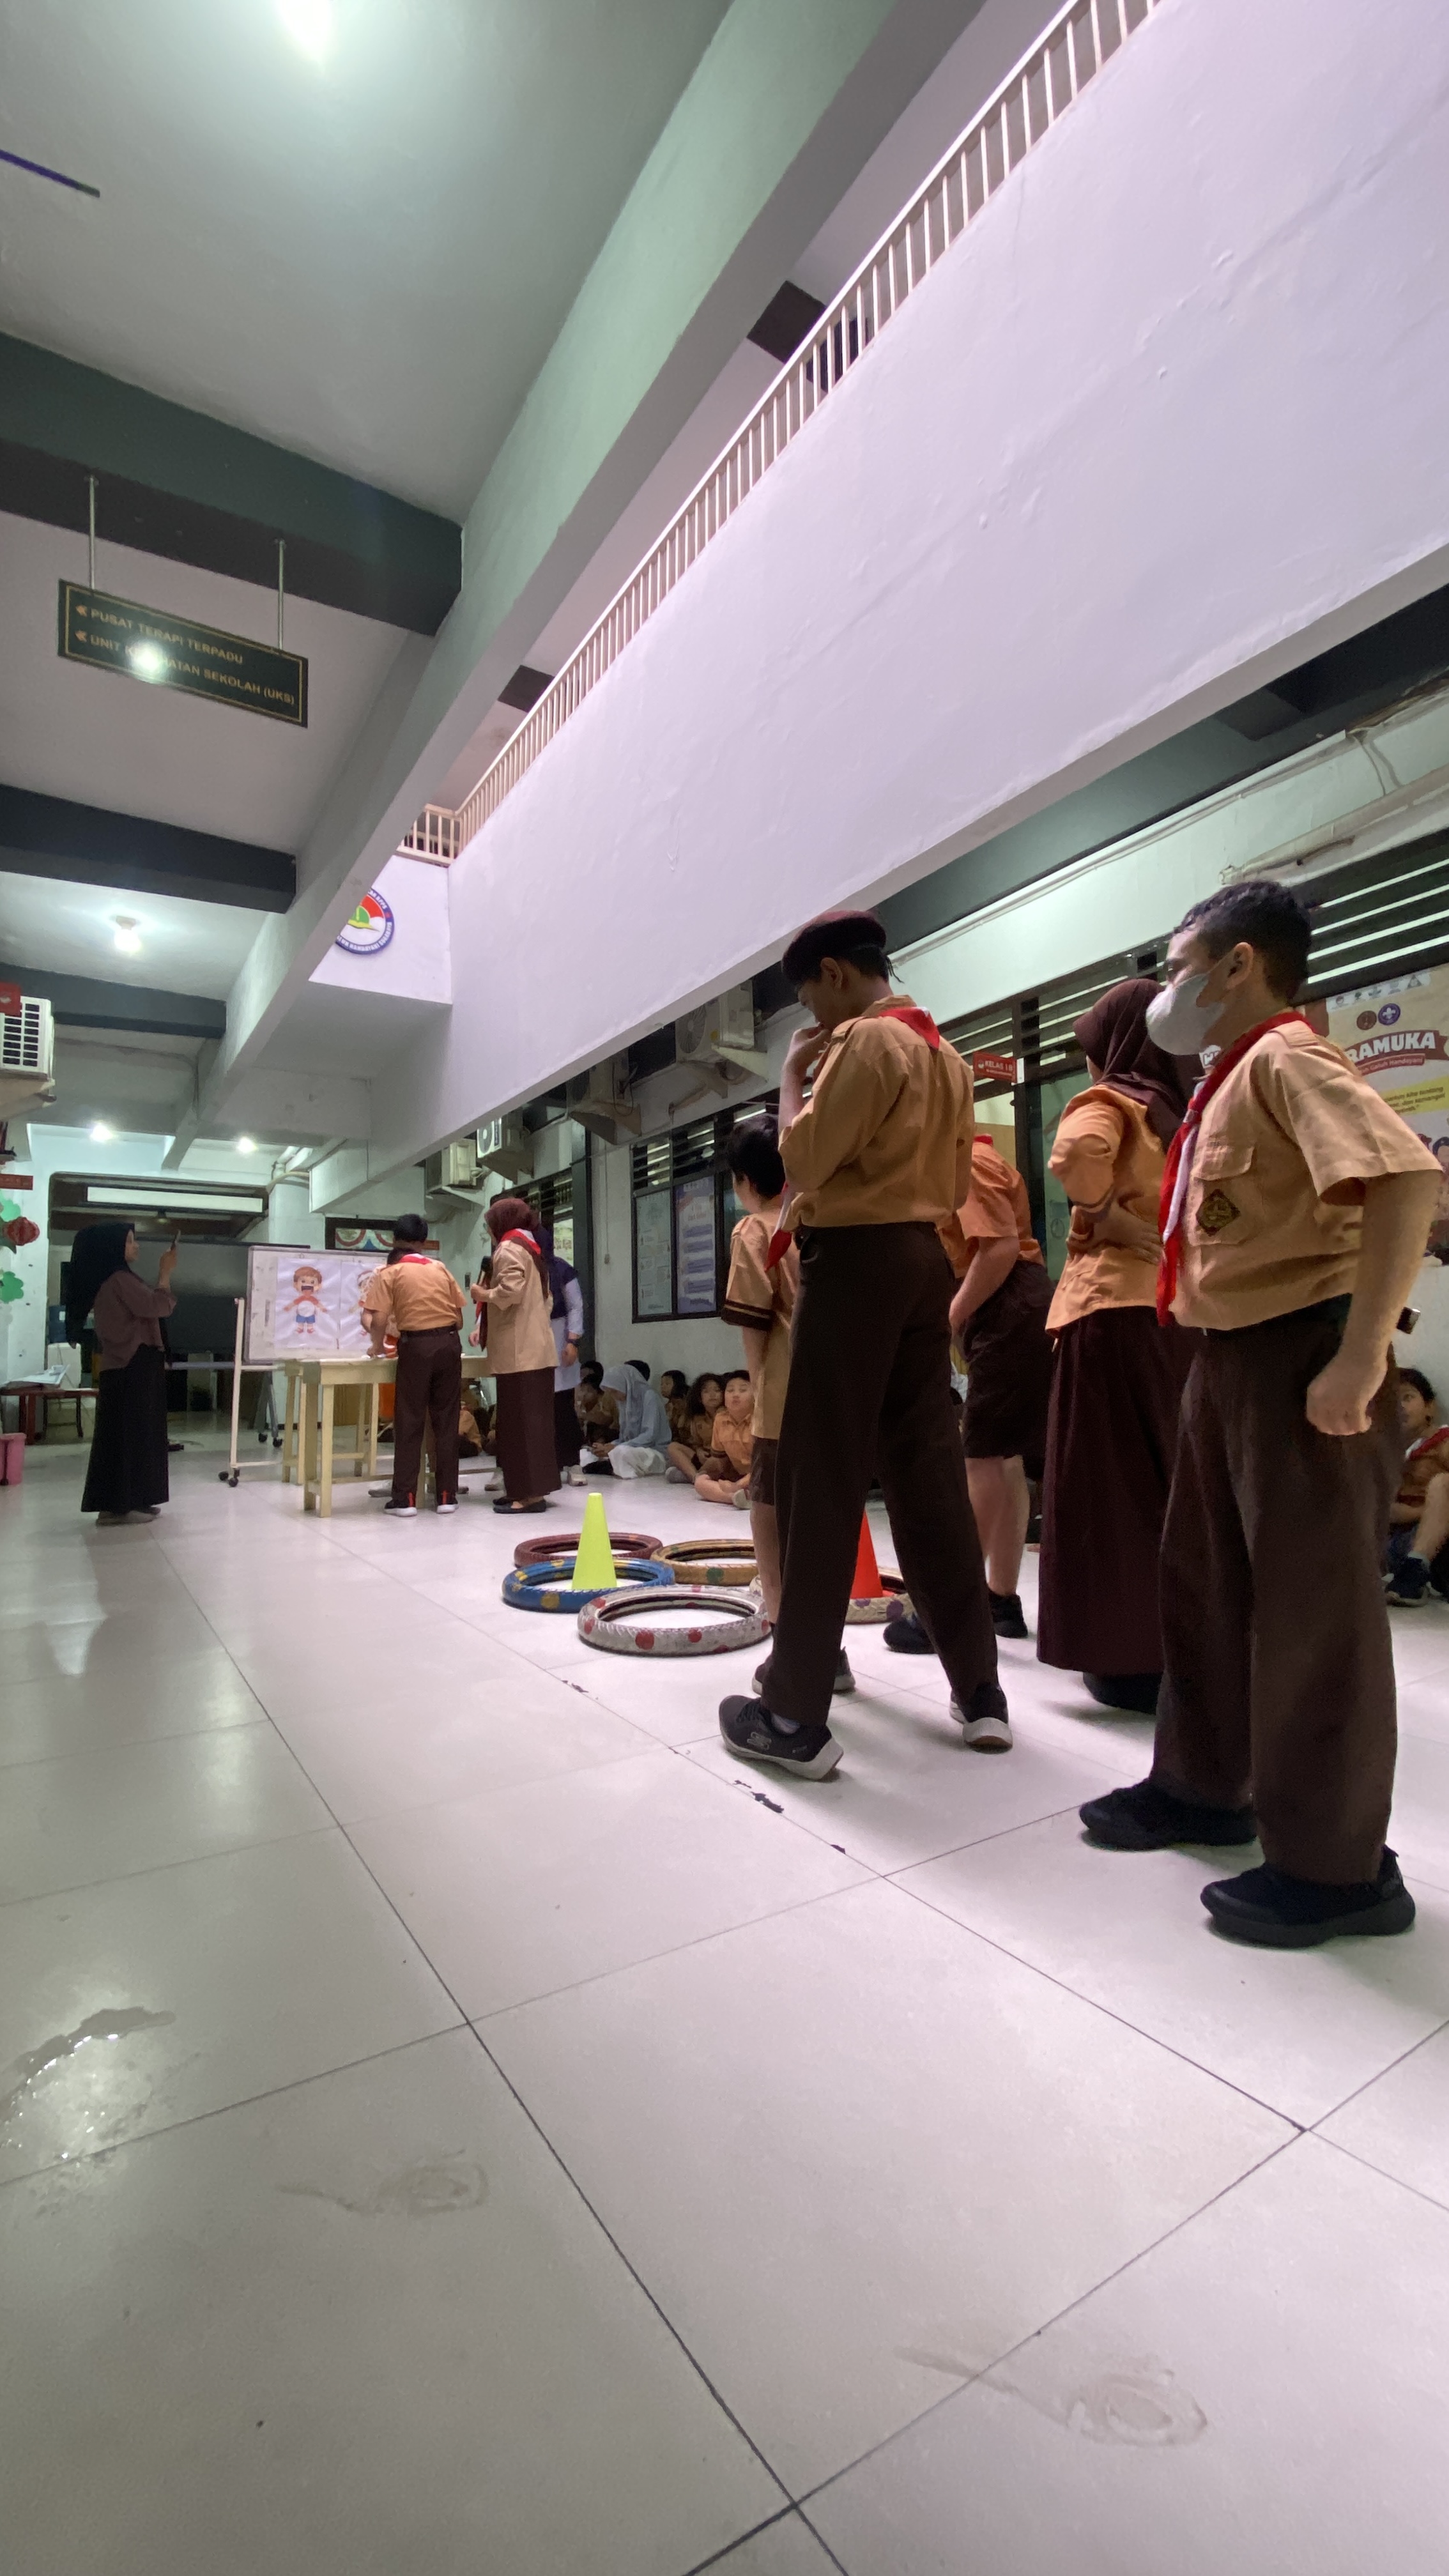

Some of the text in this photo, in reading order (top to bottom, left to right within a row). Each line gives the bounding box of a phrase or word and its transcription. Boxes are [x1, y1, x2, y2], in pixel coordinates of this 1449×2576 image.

[91, 608, 243, 665] PUSAT TERAPI TERPADU
[90, 634, 120, 652] UNIT
[203, 668, 261, 695] SEKOLAH
[263, 686, 295, 705] (UKS)
[985, 1061, 1004, 1070] KELAS
[1344, 1032, 1436, 1063] RAMUKA
